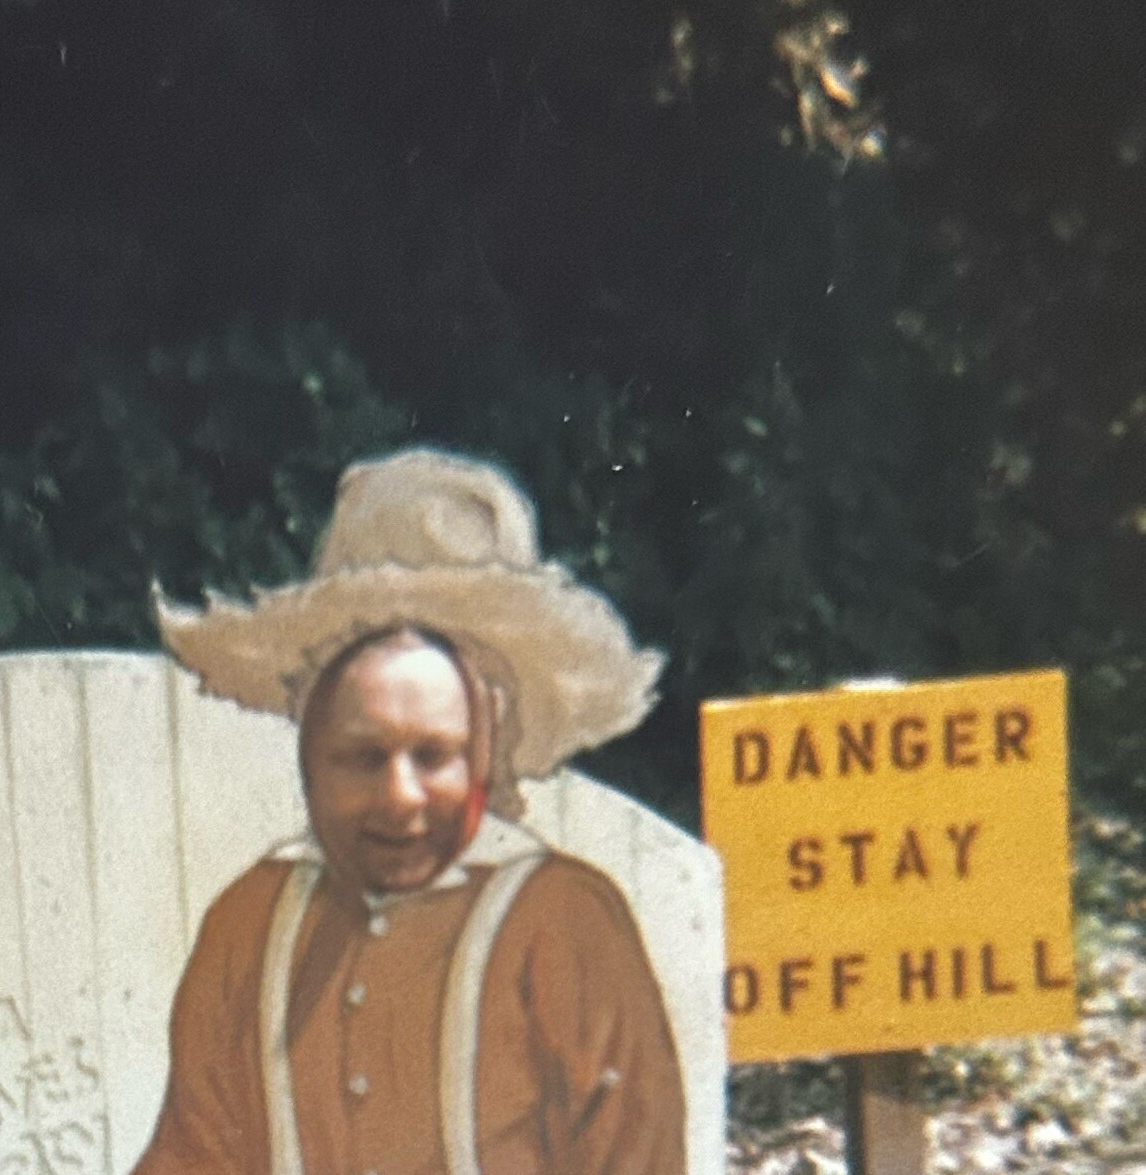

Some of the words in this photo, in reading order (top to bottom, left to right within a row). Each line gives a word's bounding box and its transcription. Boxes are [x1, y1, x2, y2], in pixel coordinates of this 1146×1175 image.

[732, 706, 1031, 785] DANGER
[786, 821, 979, 892] STAY
[725, 953, 866, 1015] OFF
[898, 940, 1072, 1002] HILL
